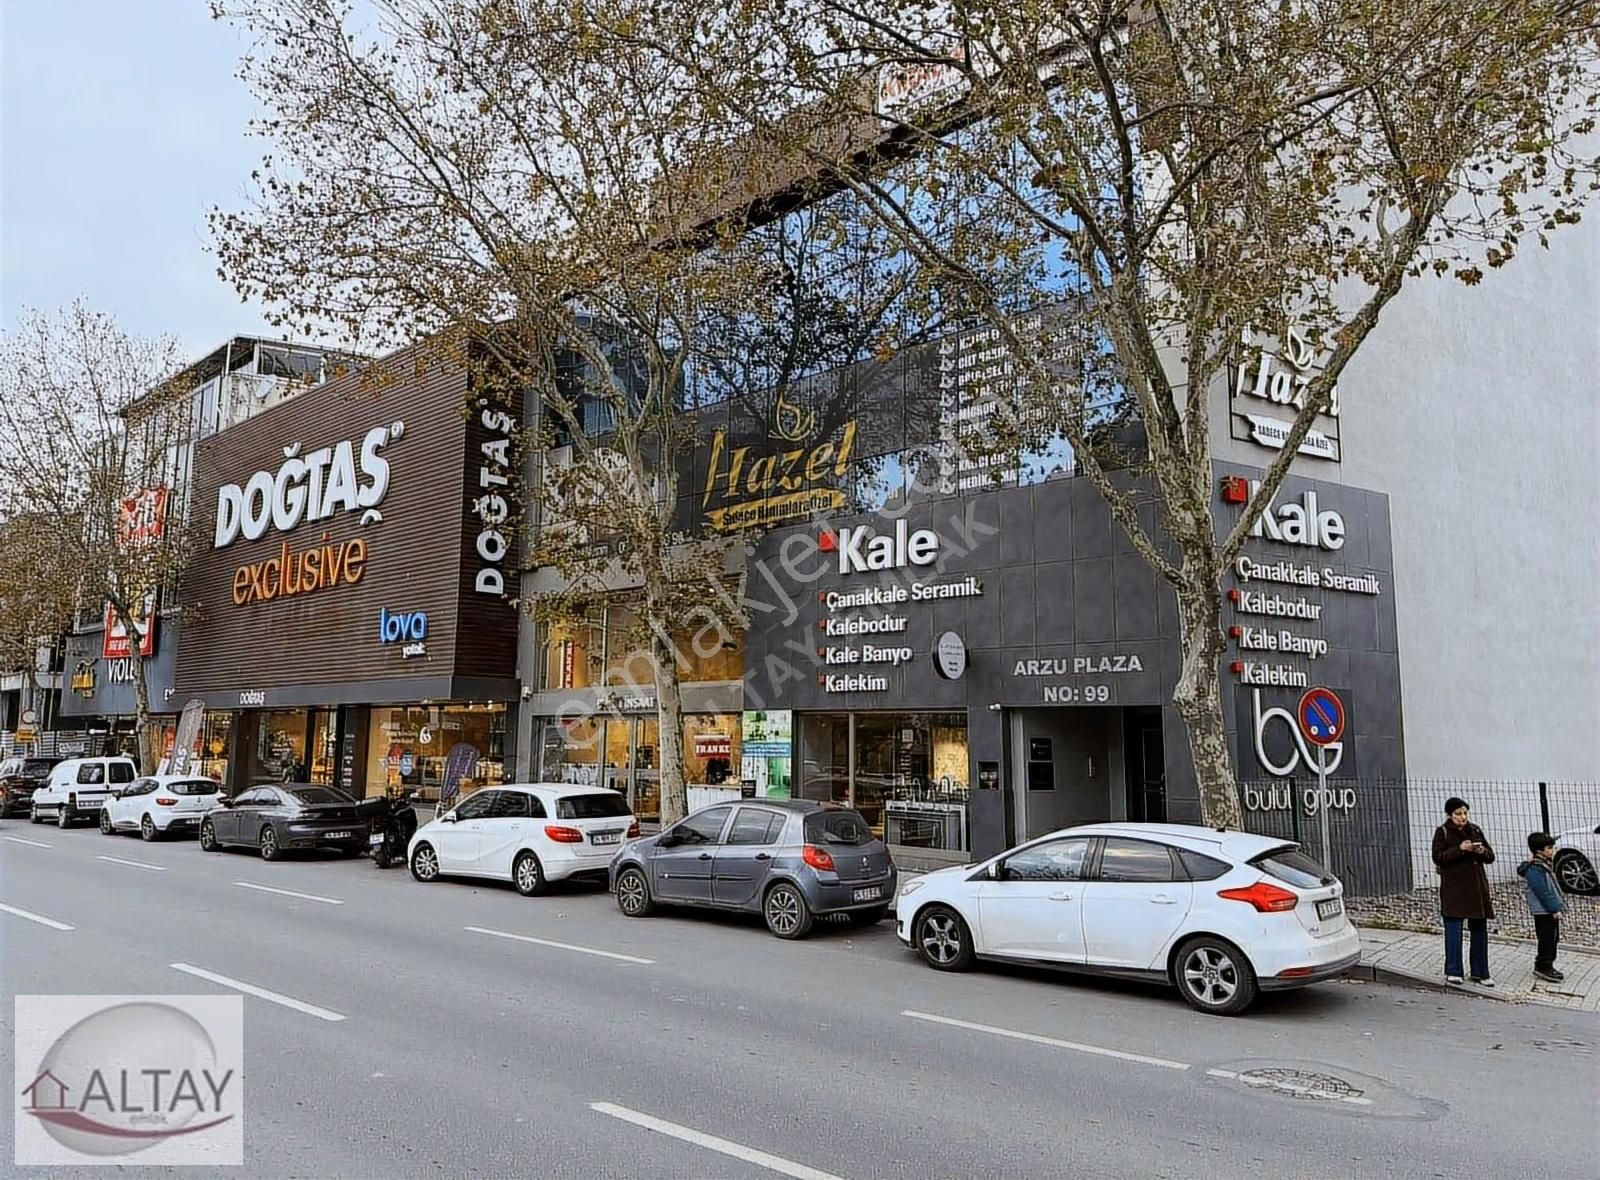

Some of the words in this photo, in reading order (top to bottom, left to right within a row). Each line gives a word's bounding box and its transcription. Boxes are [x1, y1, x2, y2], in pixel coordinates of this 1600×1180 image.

[702, 420, 857, 509] Hazel
[214, 426, 392, 548] DOĞTAŞ
[472, 409, 520, 595] DOĞTAŞ
[1248, 480, 1345, 550] Kale
[838, 519, 939, 574] Kale
[232, 533, 368, 606] exclusive
[1236, 556, 1320, 586] Çanakkale
[1321, 568, 1381, 595] Seramik
[826, 585, 908, 612] Çanakkale
[911, 577, 983, 600] Seramik
[1238, 590, 1322, 620] Kalebodur
[379, 606, 428, 644] lova
[826, 614, 908, 636] Kalebodur
[825, 646, 860, 664] Kale
[863, 645, 913, 666] Banyo
[1240, 626, 1277, 650] Kale
[1279, 630, 1328, 660] Banyo
[825, 674, 887, 692] Kalekim
[1013, 659, 1067, 676] ARZU
[1073, 655, 1143, 674] PLAZA
[1241, 662, 1308, 687] Kalekim
[1044, 686, 1080, 702] NO:
[1084, 685, 1109, 702] 99
